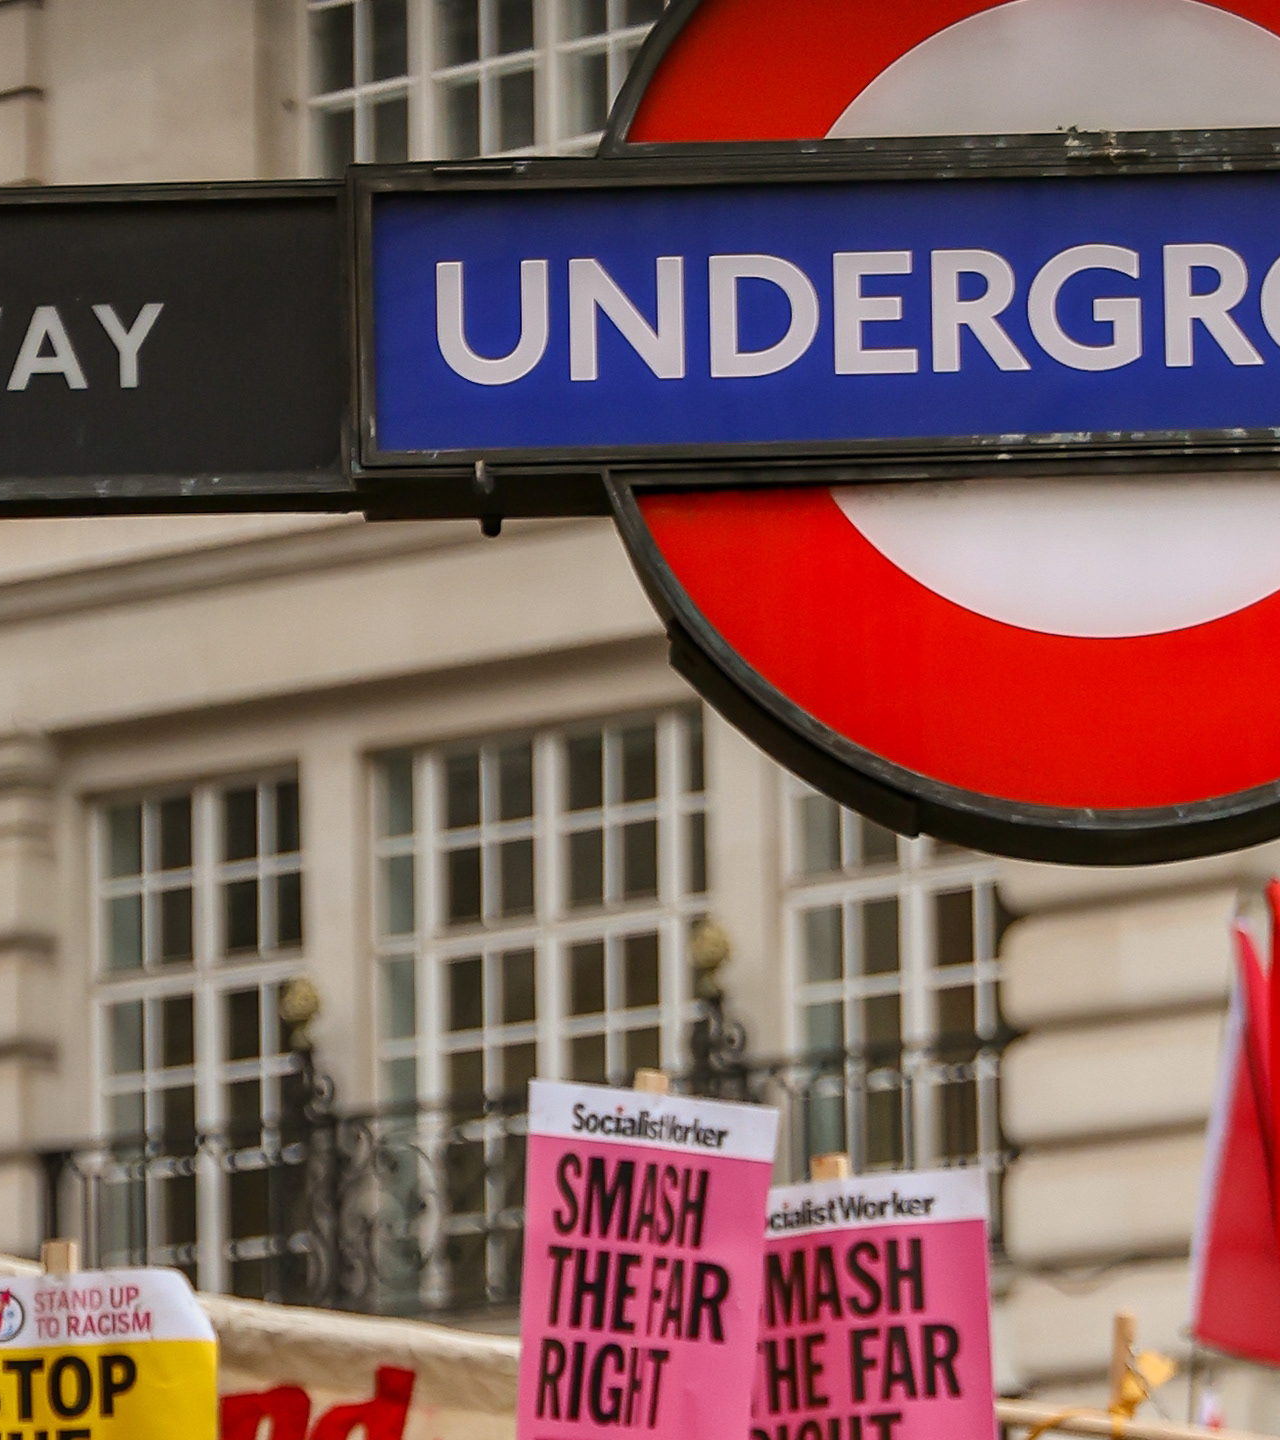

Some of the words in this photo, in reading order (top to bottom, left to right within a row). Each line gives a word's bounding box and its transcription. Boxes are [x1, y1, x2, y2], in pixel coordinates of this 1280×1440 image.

[553, 1152, 710, 1250] SMASH
[837, 1192, 936, 1221] Worker
[33, 1288, 104, 1313] STAND
[108, 1286, 141, 1308] UP
[35, 1317, 61, 1339] TO
[67, 1311, 153, 1338] RACISM
[548, 1245, 643, 1335] THE
[645, 1256, 732, 1344] FAR
[764, 1237, 925, 1328] MASH
[534, 1338, 671, 1431] RIGHT
[757, 1332, 830, 1418] HE
[848, 1323, 962, 1404] FAR
